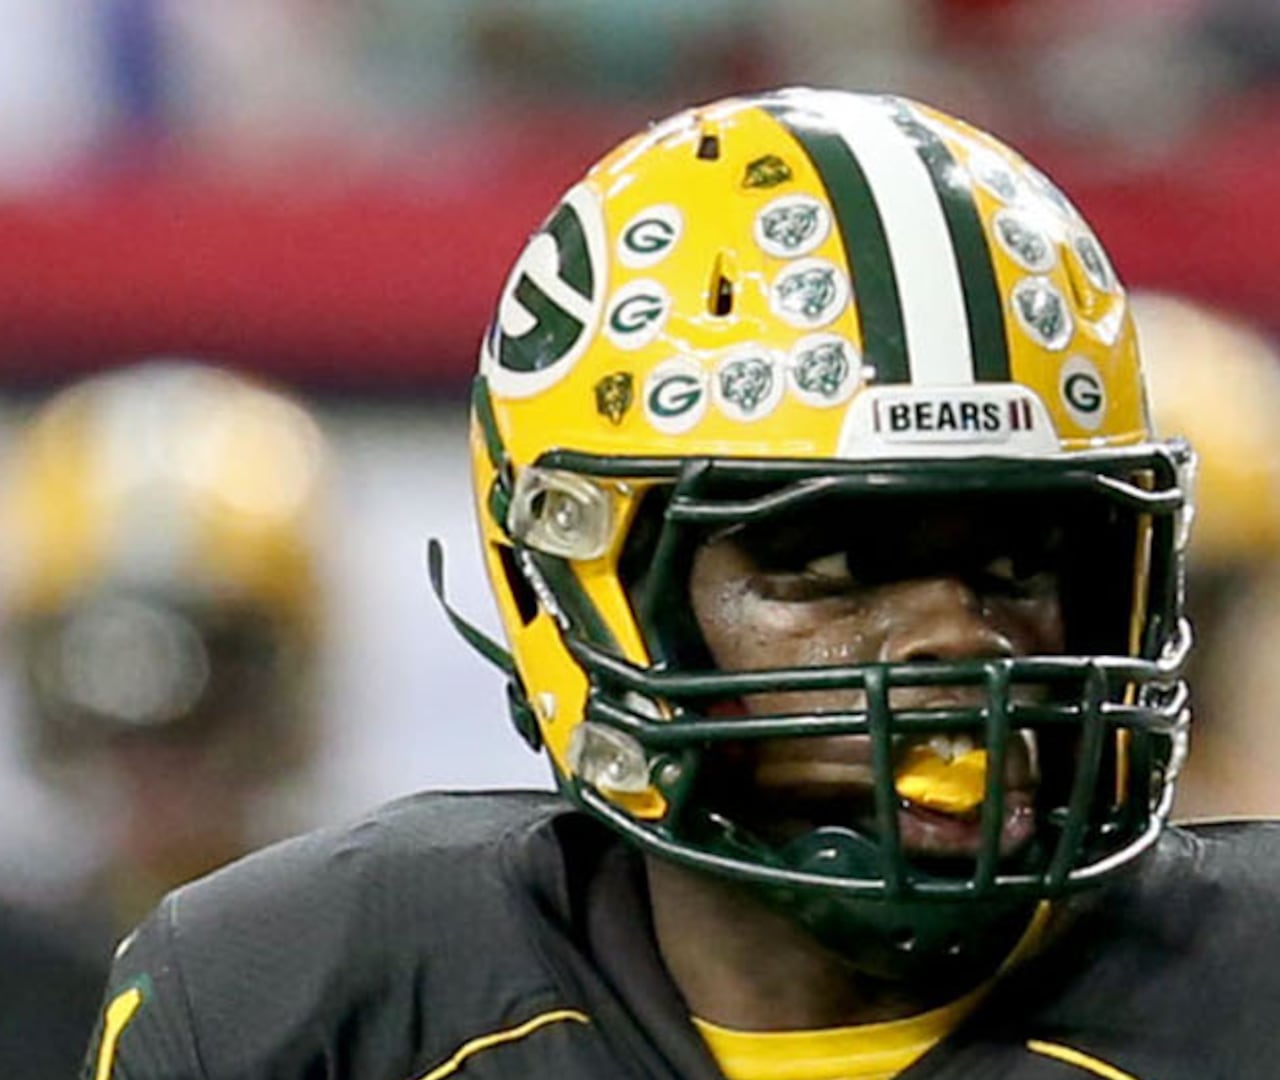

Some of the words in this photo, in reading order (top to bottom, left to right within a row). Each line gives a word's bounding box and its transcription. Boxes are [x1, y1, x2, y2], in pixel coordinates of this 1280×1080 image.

[624, 218, 675, 253] G
[610, 294, 663, 333] G
[649, 375, 703, 417] G
[1063, 373, 1102, 413] G
[889, 401, 1001, 432] BEARS
